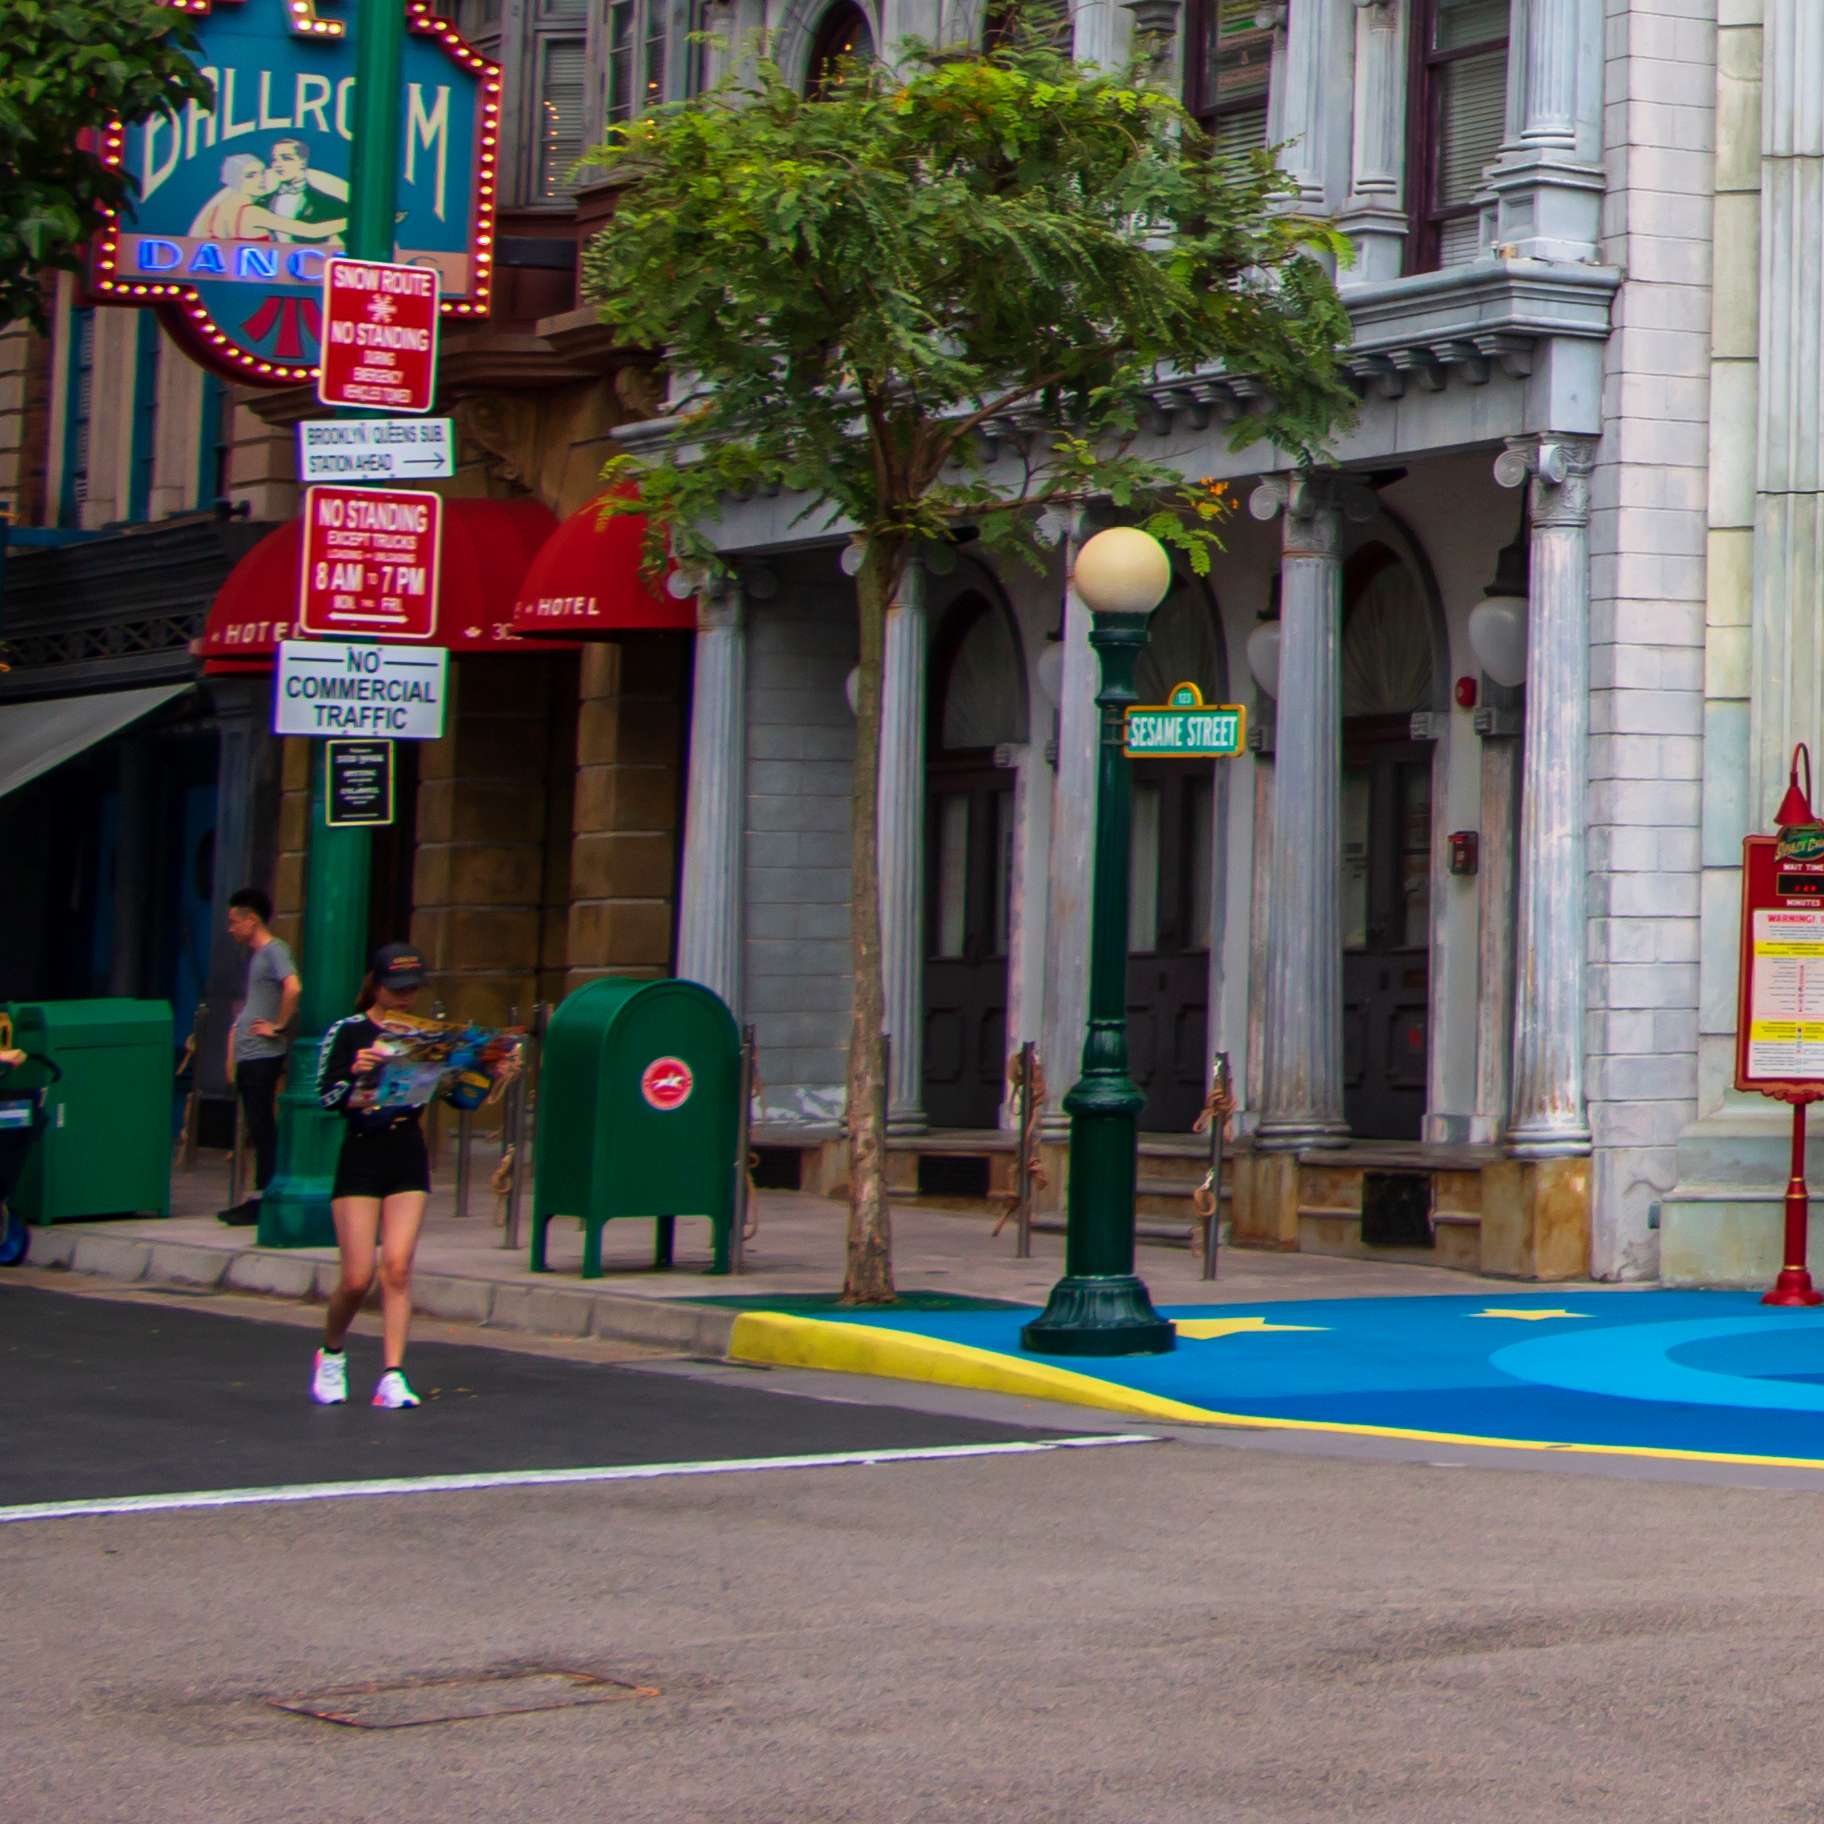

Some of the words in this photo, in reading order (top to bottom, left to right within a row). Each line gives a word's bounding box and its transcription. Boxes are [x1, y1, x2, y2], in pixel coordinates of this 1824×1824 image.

[333, 264, 380, 291] SNOW
[381, 269, 432, 297] ROUTE
[330, 319, 354, 345] NO
[355, 322, 429, 352] STANDING
[373, 425, 416, 445] QUEENS
[309, 454, 354, 474] STATION
[355, 453, 392, 472] AHEAD
[318, 498, 344, 528] NO
[346, 499, 428, 534] STANDING
[327, 530, 371, 547] EXCEPT
[315, 561, 329, 591] 8
[330, 562, 364, 592] AM
[381, 565, 394, 594] 7
[396, 566, 427, 595] PM
[536, 596, 601, 617] HOTEL
[346, 648, 381, 674] NO
[285, 675, 438, 704] COMMERCIAL
[313, 703, 408, 731] TRAFFIC
[1131, 716, 1183, 747] SESAME
[1186, 716, 1239, 747] STREET
[1782, 863, 1803, 872] WAIT
[1806, 863, 1824, 872] TIME
[1786, 898, 1821, 907] MINUTES
[1767, 913, 1816, 923] WARNING!
